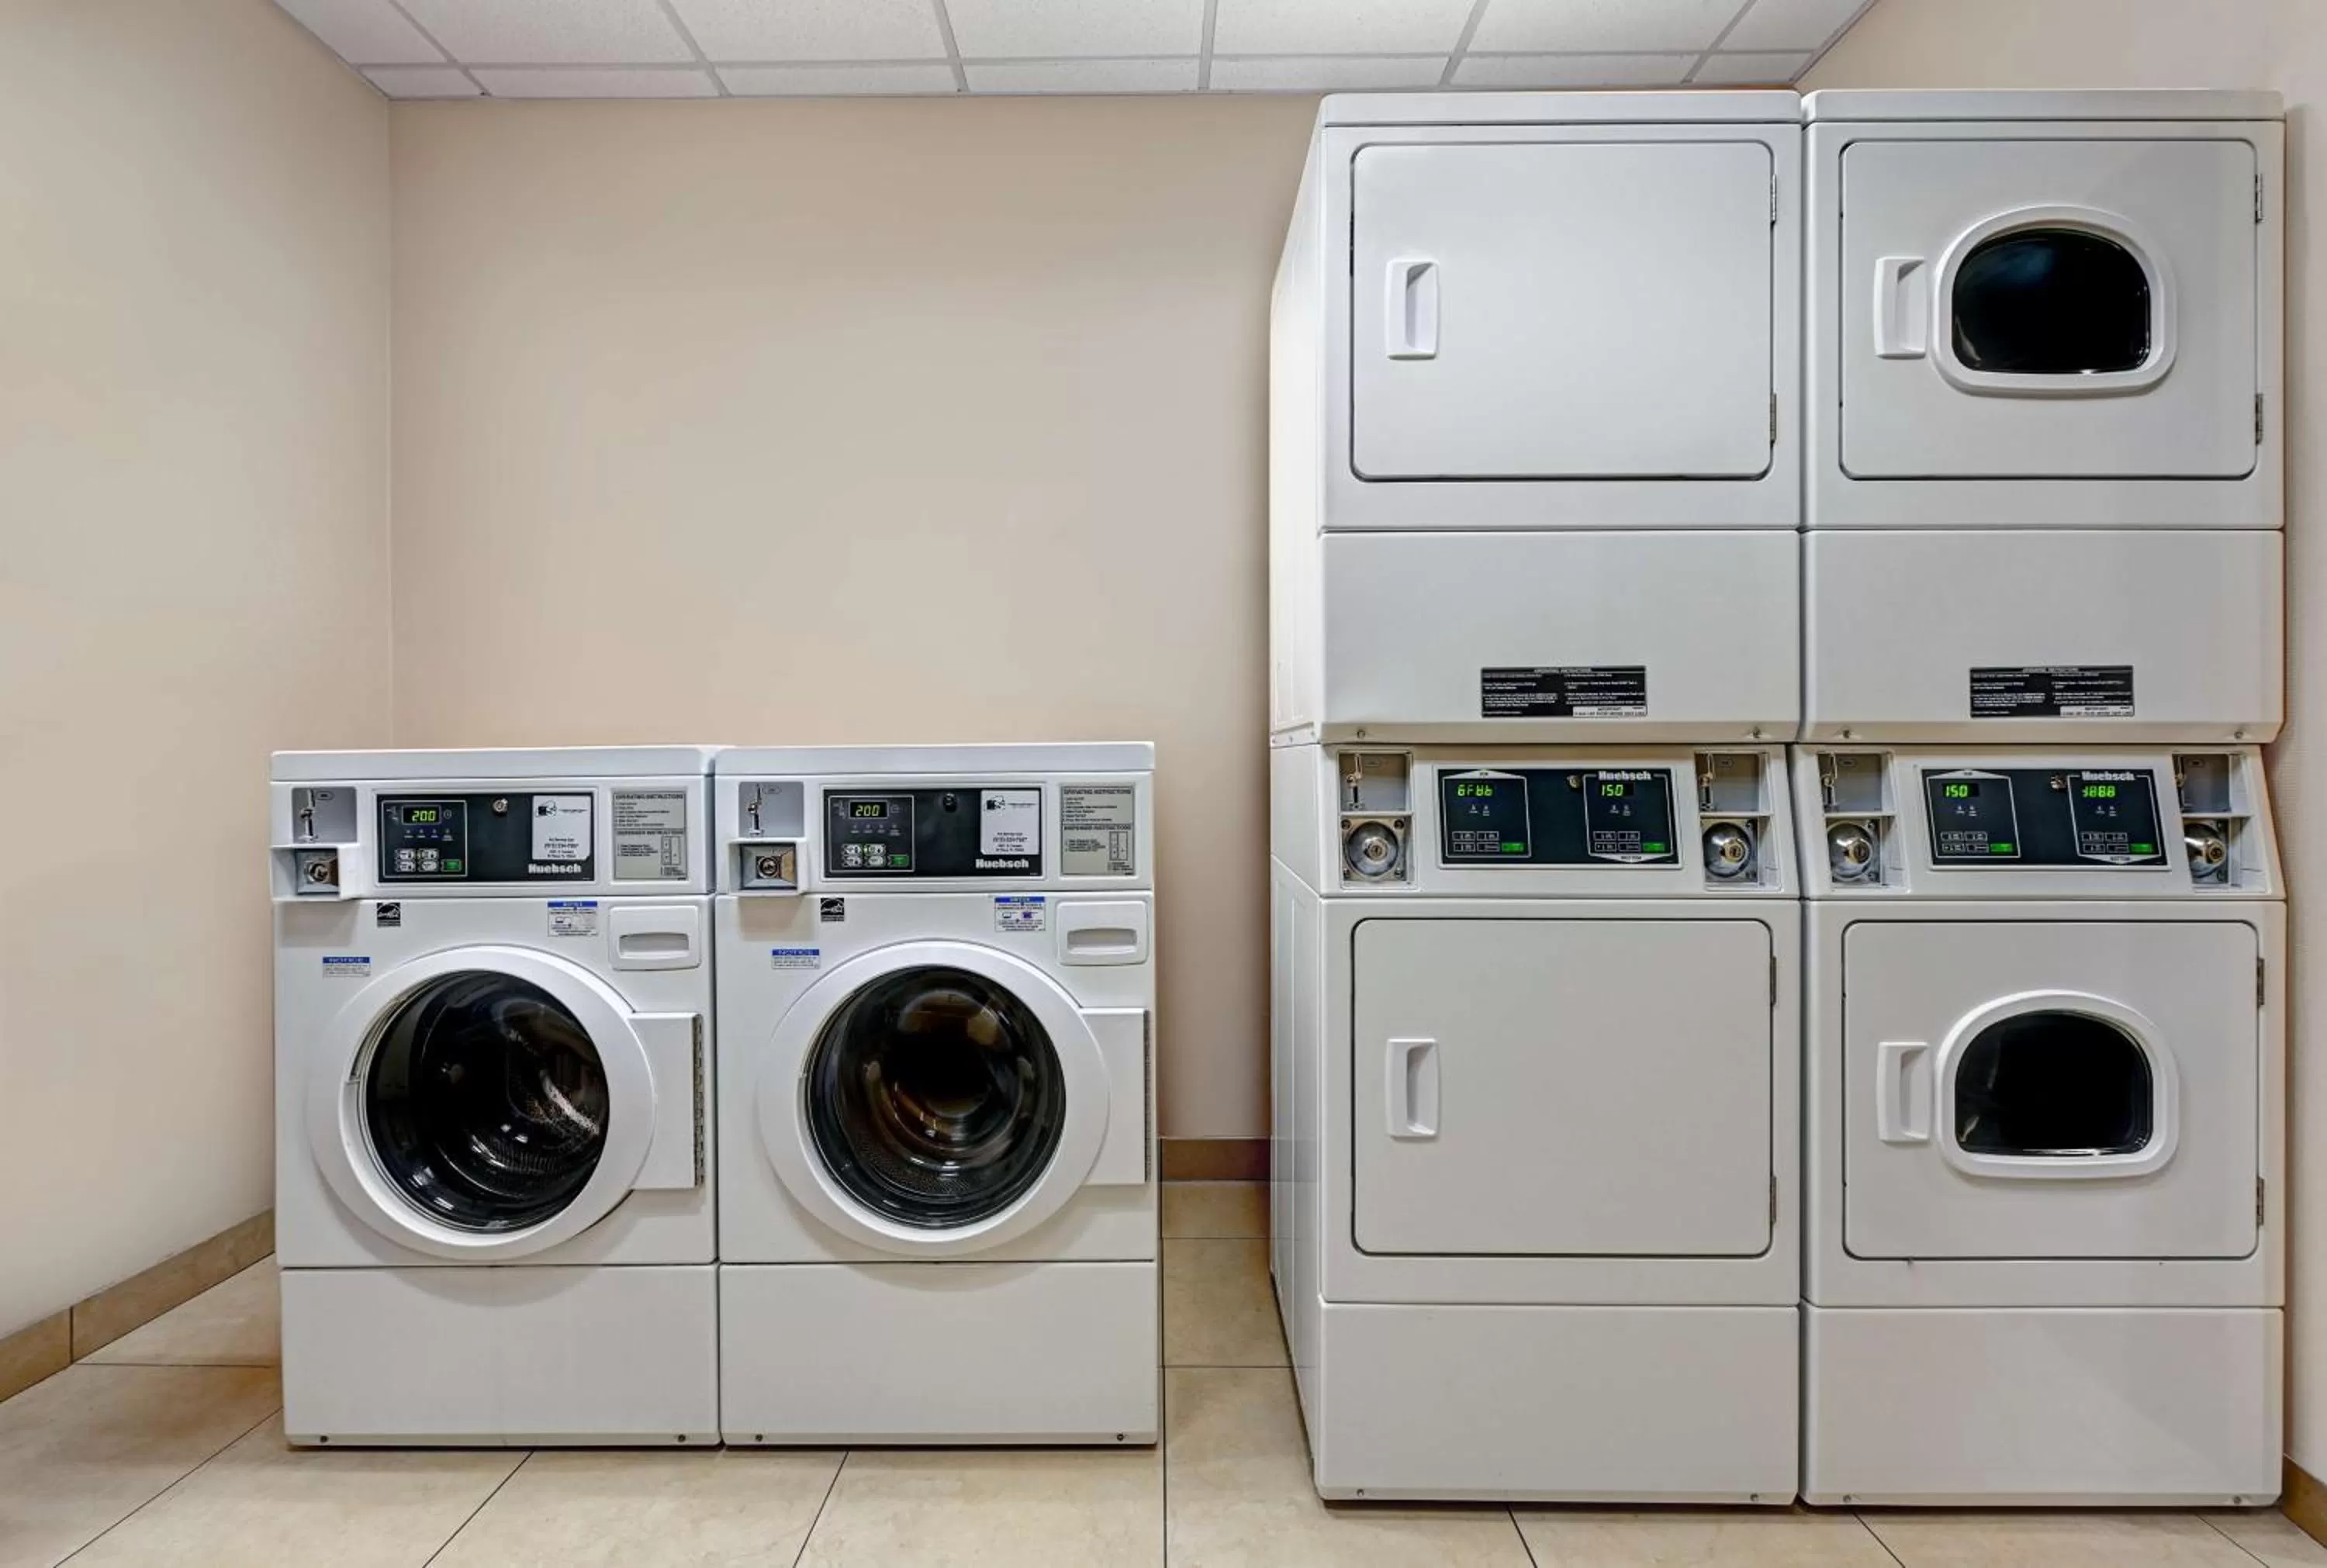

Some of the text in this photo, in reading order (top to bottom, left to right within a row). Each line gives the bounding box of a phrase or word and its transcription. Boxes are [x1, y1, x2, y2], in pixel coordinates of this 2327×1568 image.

[1599, 771, 1651, 780] Huebsch
[2081, 771, 2135, 781] Huebsch
[1601, 784, 1623, 796] 150
[1945, 785, 1968, 797] 150
[412, 810, 437, 821] 200
[856, 804, 880, 817] 200
[528, 863, 582, 874] Huebsch
[975, 858, 1029, 869] Huebsch
